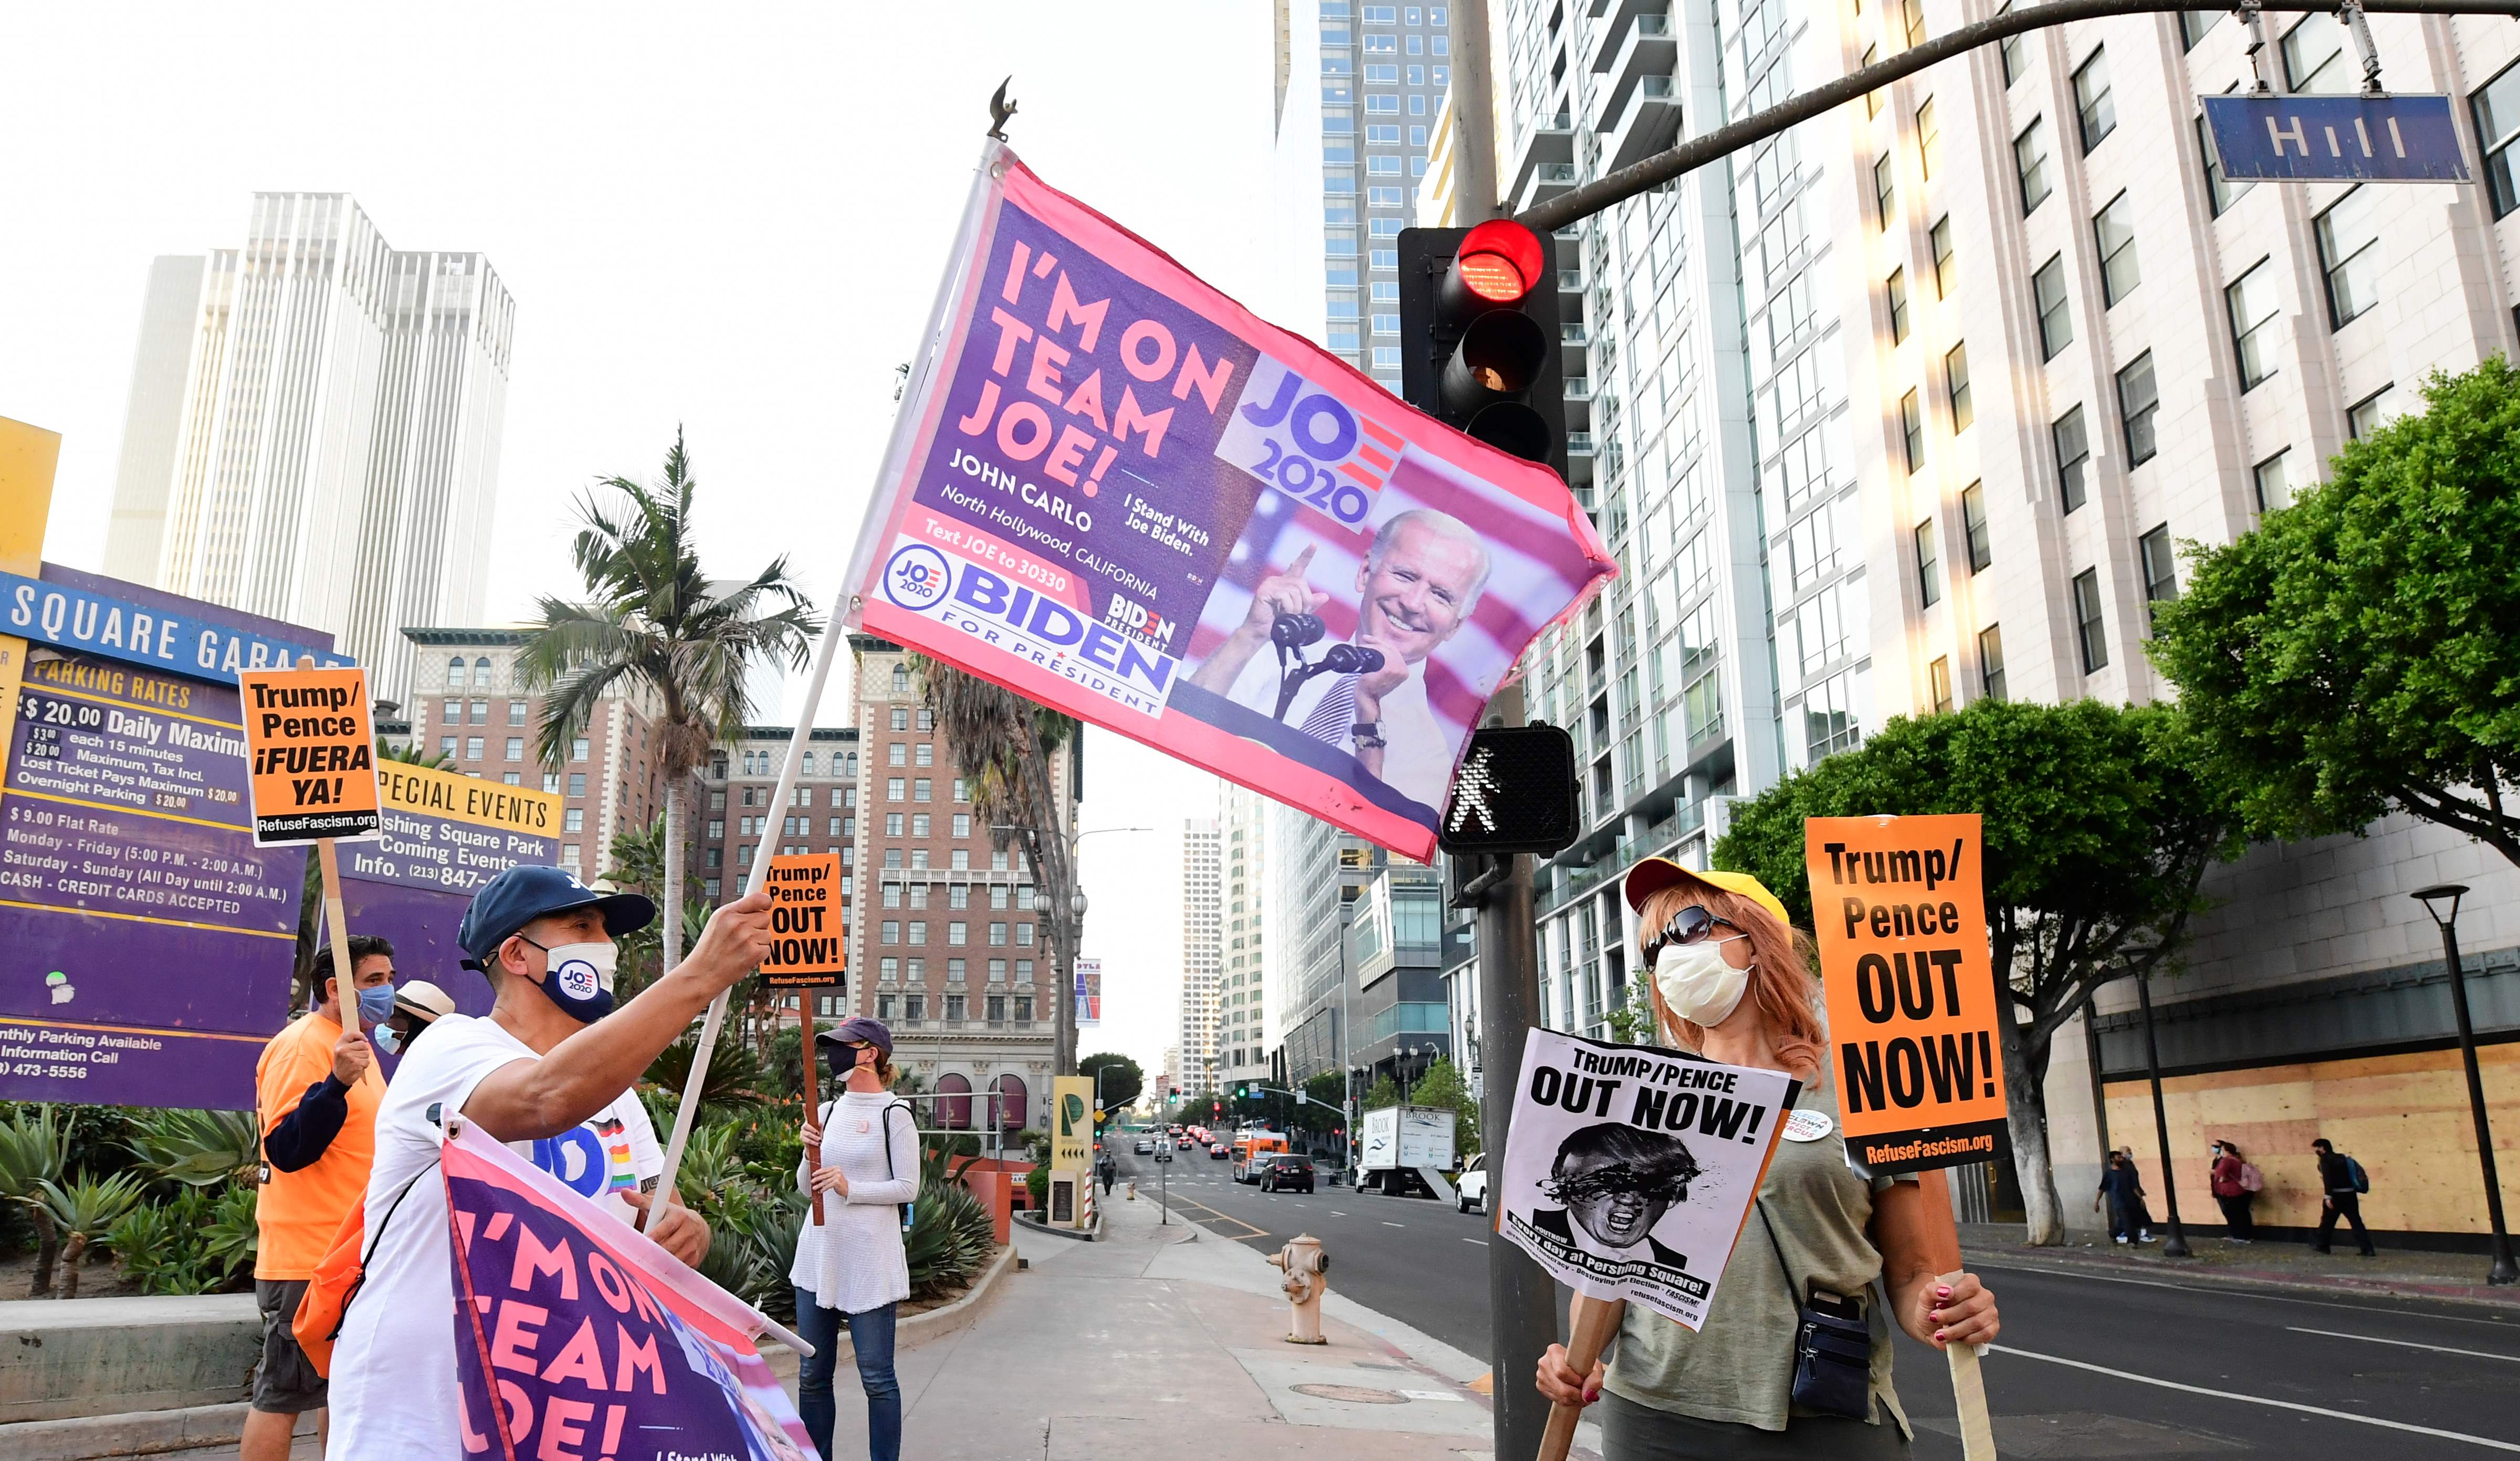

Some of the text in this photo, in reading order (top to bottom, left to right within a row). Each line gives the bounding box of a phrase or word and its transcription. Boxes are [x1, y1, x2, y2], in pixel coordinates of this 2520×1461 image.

[2265, 116, 2406, 158] Hill
[1002, 239, 1234, 415] I'M ON
[991, 305, 1175, 458] TEAM
[958, 379, 1118, 498] JOE!
[1240, 370, 1405, 493] JOE
[949, 448, 1092, 532] JOHN CARLO
[1250, 438, 1368, 523] 2020
[1124, 493, 1210, 546] I Stand With
[1125, 512, 1193, 556] Joe Biden.
[925, 517, 1066, 592] Text JOE to 30330
[941, 484, 1158, 600] North Hollywood, CALIFORNIA
[896, 560, 941, 588] JOE
[899, 579, 933, 597] 2020
[10, 584, 178, 660] SQUARE
[953, 562, 1173, 693] BIDEN
[1104, 615, 1168, 653] PRESIDENT
[1108, 593, 1176, 644] BIDEN
[941, 611, 1158, 713] FOR PRESIDENT
[34, 661, 191, 709] PARKING RATES
[250, 681, 359, 712] Trump/
[44, 701, 101, 726] 20.00
[108, 710, 162, 745] Daily
[262, 713, 356, 738] Pence
[69, 734, 104, 748] each
[109, 740, 125, 752] 15
[129, 745, 183, 763] minutes
[77, 750, 149, 774] Maximum,
[153, 763, 174, 777] Tax
[178, 765, 204, 783] Incl.
[255, 744, 370, 776] ¡FUERA
[17, 771, 90, 794] Overnight
[93, 785, 146, 805] Parking
[20, 756, 52, 772] Lost
[56, 761, 99, 779] Ticket
[102, 769, 135, 787] Pays
[139, 775, 204, 797] Maximum
[291, 777, 343, 806] YA!
[23, 810, 53, 825] 9.00
[57, 815, 85, 831] Flat
[88, 819, 119, 836] Rate
[258, 814, 377, 833] RefuseFascism.org
[467, 788, 547, 828] EVENTS
[7, 828, 63, 851] Monday
[77, 839, 121, 859] Friday
[125, 846, 158, 862] (5:00
[162, 851, 188, 867] P.M.
[201, 857, 228, 873] 2:00
[231, 863, 262, 880] A.M.)
[379, 835, 518, 871] Coming Events
[439, 823, 501, 849] Square
[507, 835, 544, 857] Park
[3, 849, 69, 873] Saturday
[82, 860, 134, 882] Sunday
[138, 868, 161, 884] (All
[165, 873, 190, 890] Day
[194, 879, 223, 892] until
[226, 881, 253, 896] 2:00
[255, 886, 287, 904] A.M.)
[354, 853, 400, 878] Info.
[409, 864, 438, 880] (213)
[766, 863, 831, 884] Trump/
[1824, 838, 1964, 891] Trump/
[0, 871, 43, 889] CASH
[58, 879, 112, 897] CREDIT
[116, 887, 164, 904] CARDS
[168, 893, 240, 914] ACCEPTED
[769, 886, 826, 902] Pence
[772, 906, 826, 933] OUT
[1841, 896, 1959, 940] Pence
[764, 938, 838, 966] NOW!
[564, 970, 593, 987] JOE
[569, 982, 592, 993] 2020
[1856, 949, 1963, 1024] OUT
[1, 1045, 119, 1064] Information Call
[39, 1030, 95, 1048] Parking
[98, 1035, 162, 1050] Available
[13, 1063, 87, 1079] 473-5556
[1573, 1047, 1738, 1095] TRUMP/PENCE
[1841, 1030, 1996, 1115] NOW!
[1406, 1110, 1441, 1121] BROOK
[1530, 1065, 1622, 1118] OUT
[1631, 1085, 1767, 1145] NOW!
[1372, 1117, 1389, 1134] BROOK
[1865, 1132, 1993, 1164] RefuseFascism.org
[1511, 1214, 1704, 1295] Every day at Pershing Square!
[1534, 1225, 1568, 1244] #OUTNOW
[1536, 1244, 1570, 1271] Theocracy
[1577, 1267, 1615, 1286] Destroying
[1630, 1277, 1660, 1291] Election
[1665, 1289, 1700, 1308] FASCISM!
[1630, 1289, 1698, 1322] refusefascism.org
